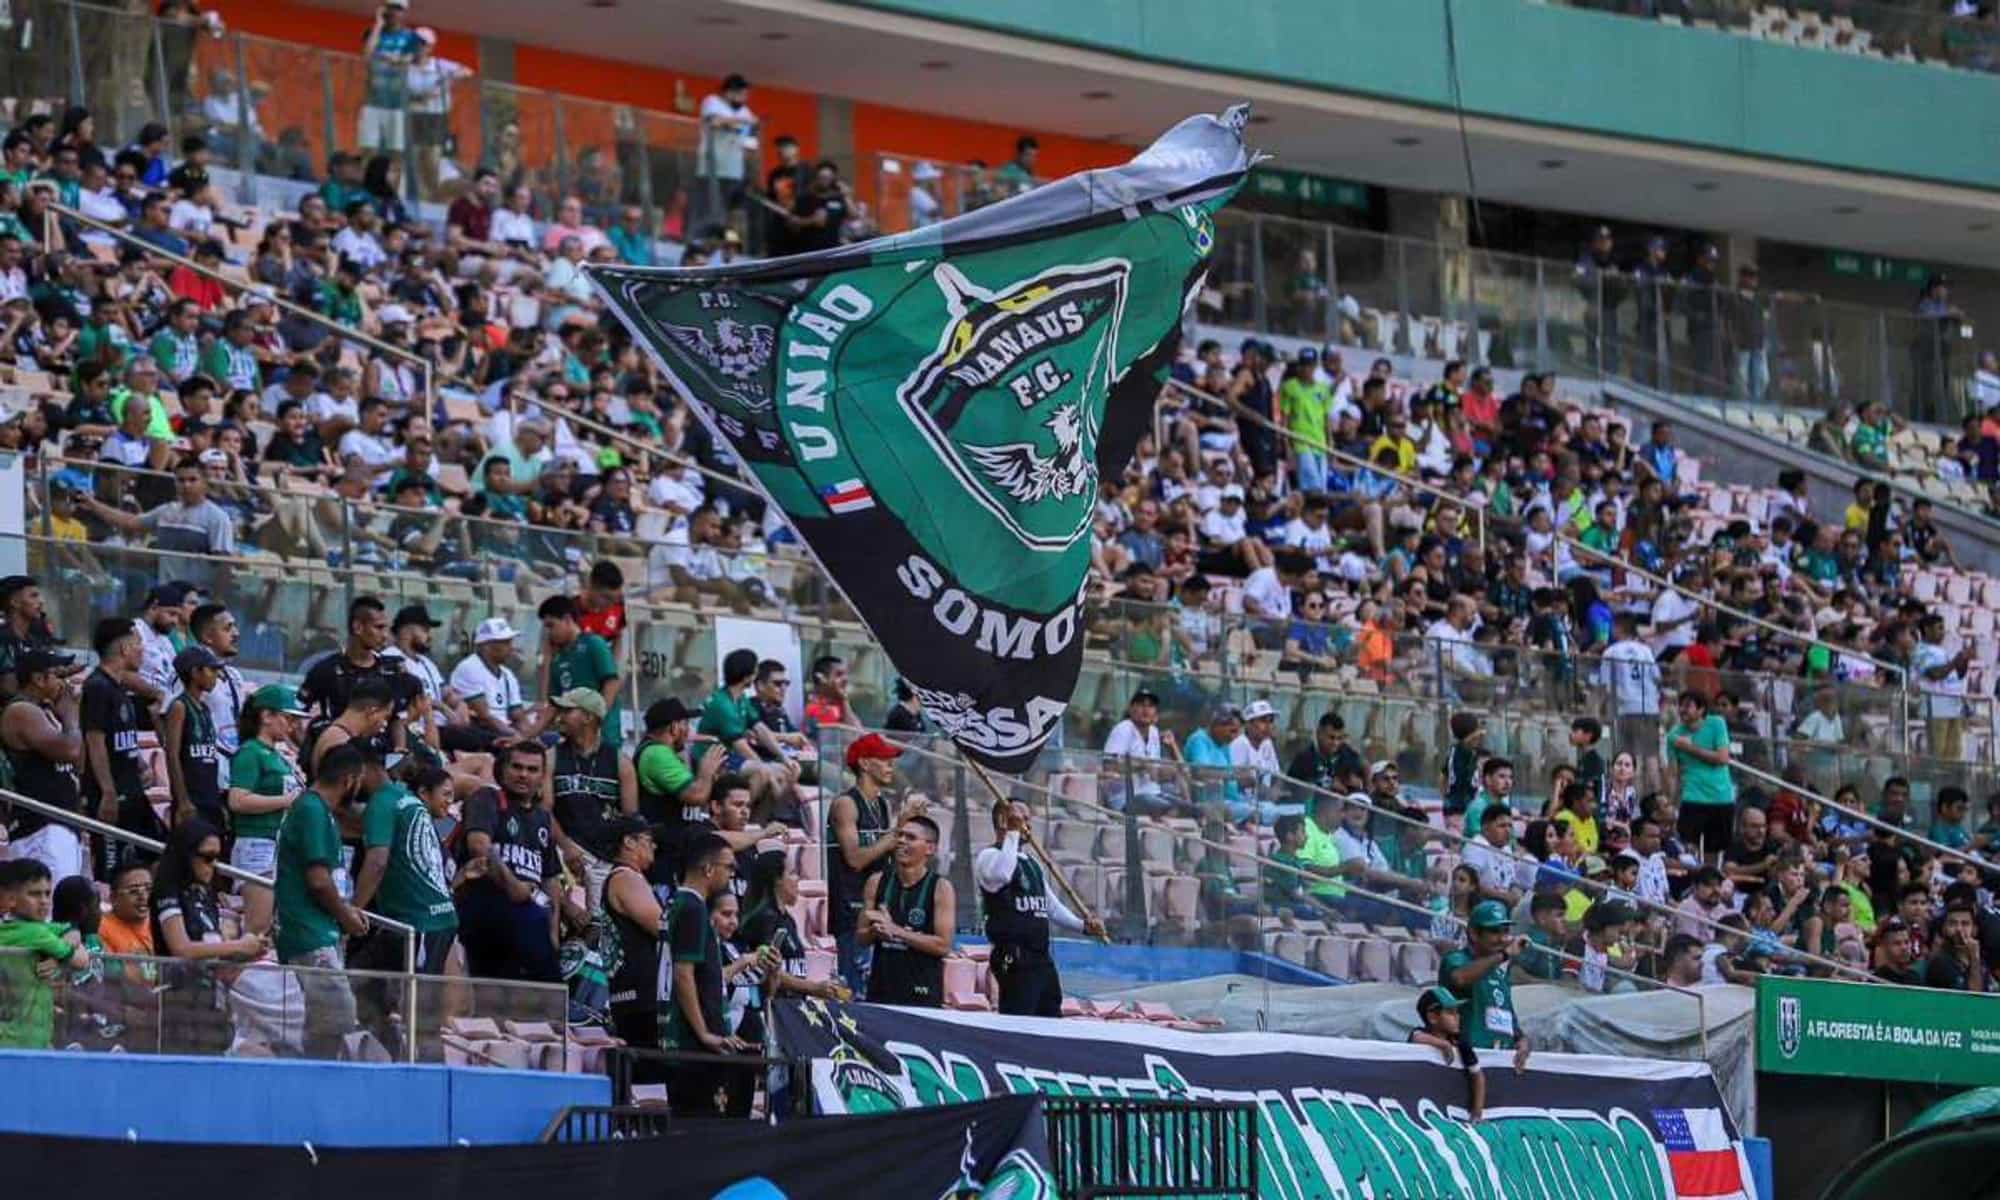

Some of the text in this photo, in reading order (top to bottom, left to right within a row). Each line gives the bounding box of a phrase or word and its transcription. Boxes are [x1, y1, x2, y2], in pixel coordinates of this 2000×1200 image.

[1806, 1020, 1816, 1037] A
[1816, 1020, 1875, 1041] FLORESTA
[1876, 1019, 1884, 1041] É
[1884, 1028, 1893, 1042] A
[1893, 1027, 1924, 1045] BOLA
[1925, 1030, 1941, 1047] DA
[1941, 1031, 1963, 1049] VEZ
